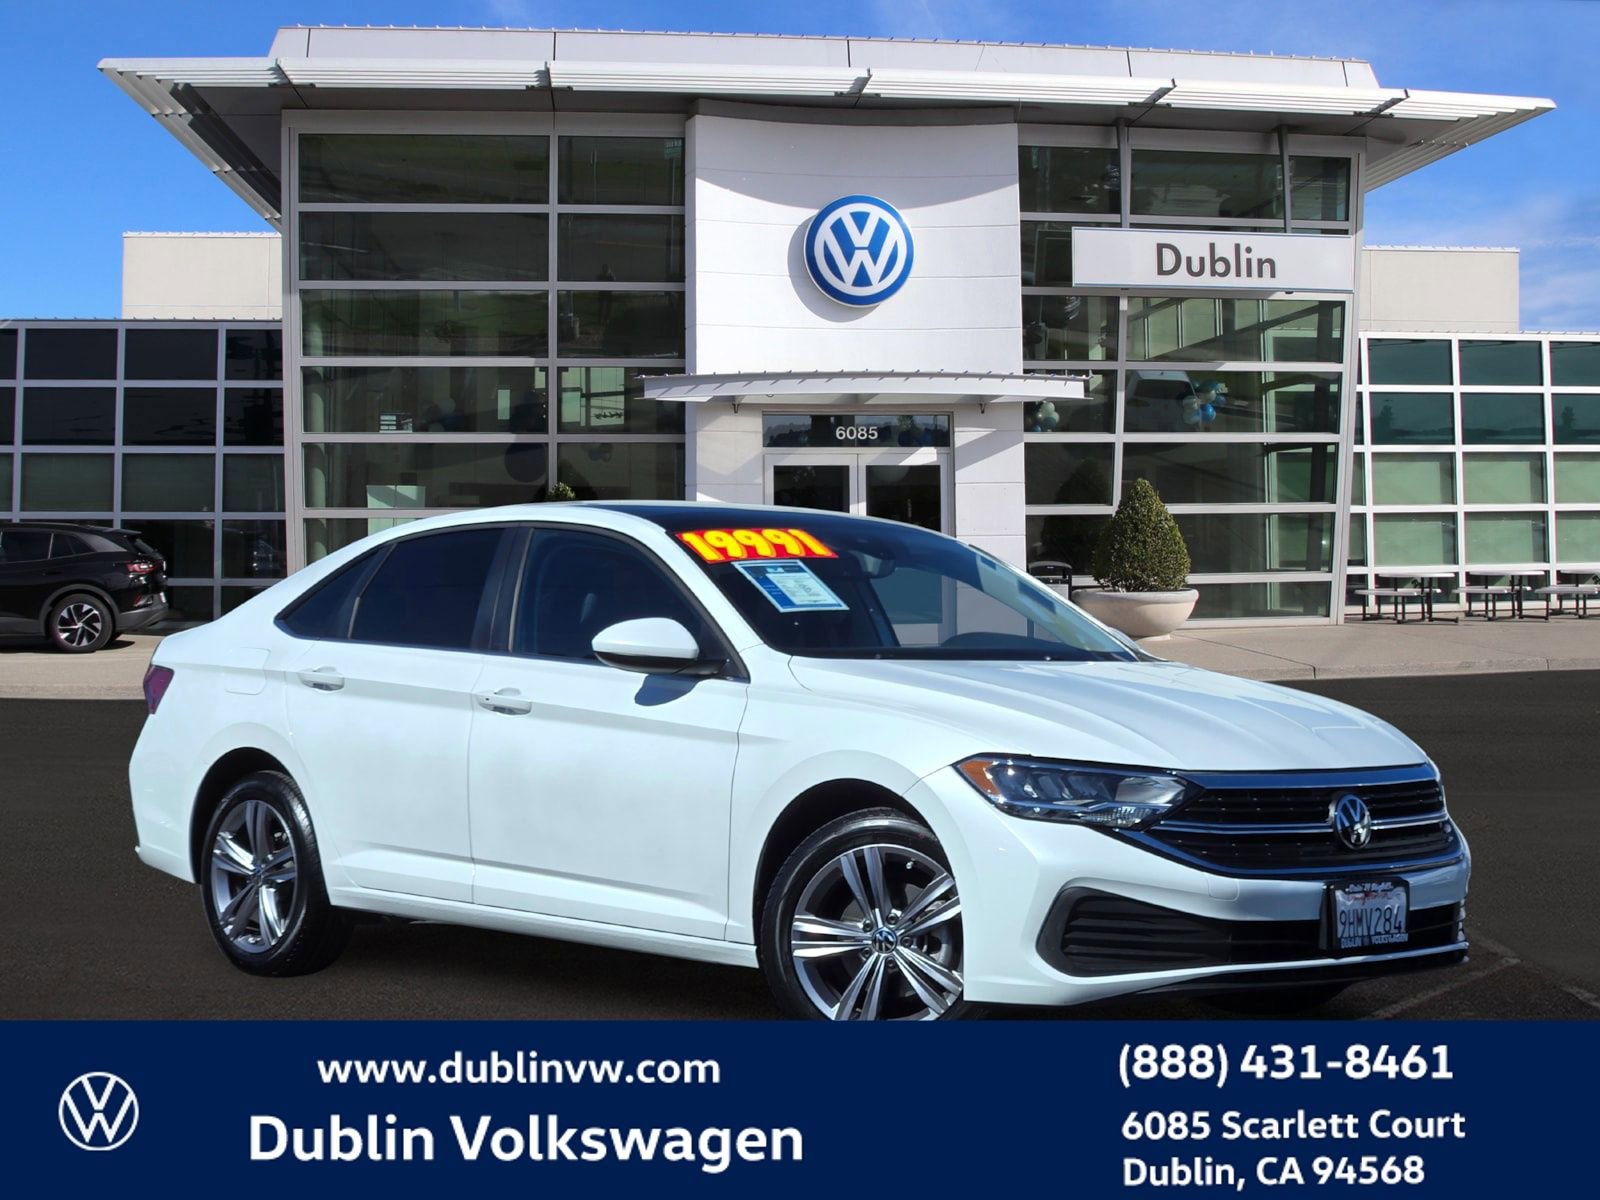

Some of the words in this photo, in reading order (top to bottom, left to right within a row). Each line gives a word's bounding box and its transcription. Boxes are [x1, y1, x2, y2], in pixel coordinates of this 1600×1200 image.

[813, 203, 908, 297] VW
[1156, 242, 1276, 279] Dublin
[835, 426, 878, 440] 6085
[681, 528, 832, 562] 19991
[1340, 906, 1402, 938] 9HMV284
